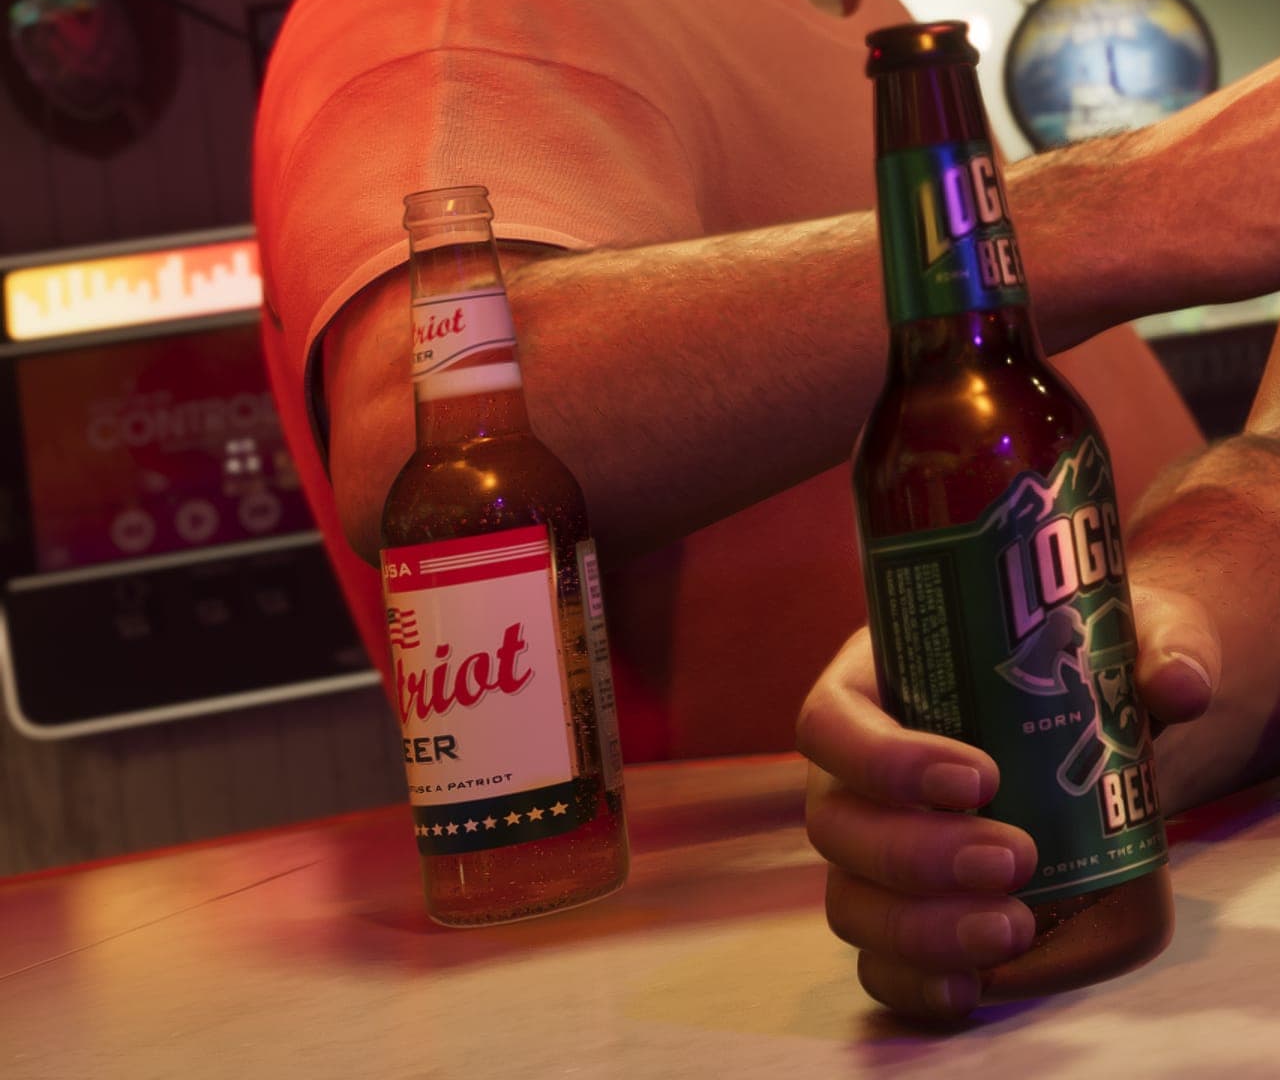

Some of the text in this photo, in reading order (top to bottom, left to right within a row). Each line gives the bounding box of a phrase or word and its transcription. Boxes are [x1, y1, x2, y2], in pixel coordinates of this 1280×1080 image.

[1022, 711, 1081, 733] BORN
[448, 772, 513, 791] PATRIOT
[1042, 854, 1100, 877] DRINK
[1106, 844, 1134, 860] THE
